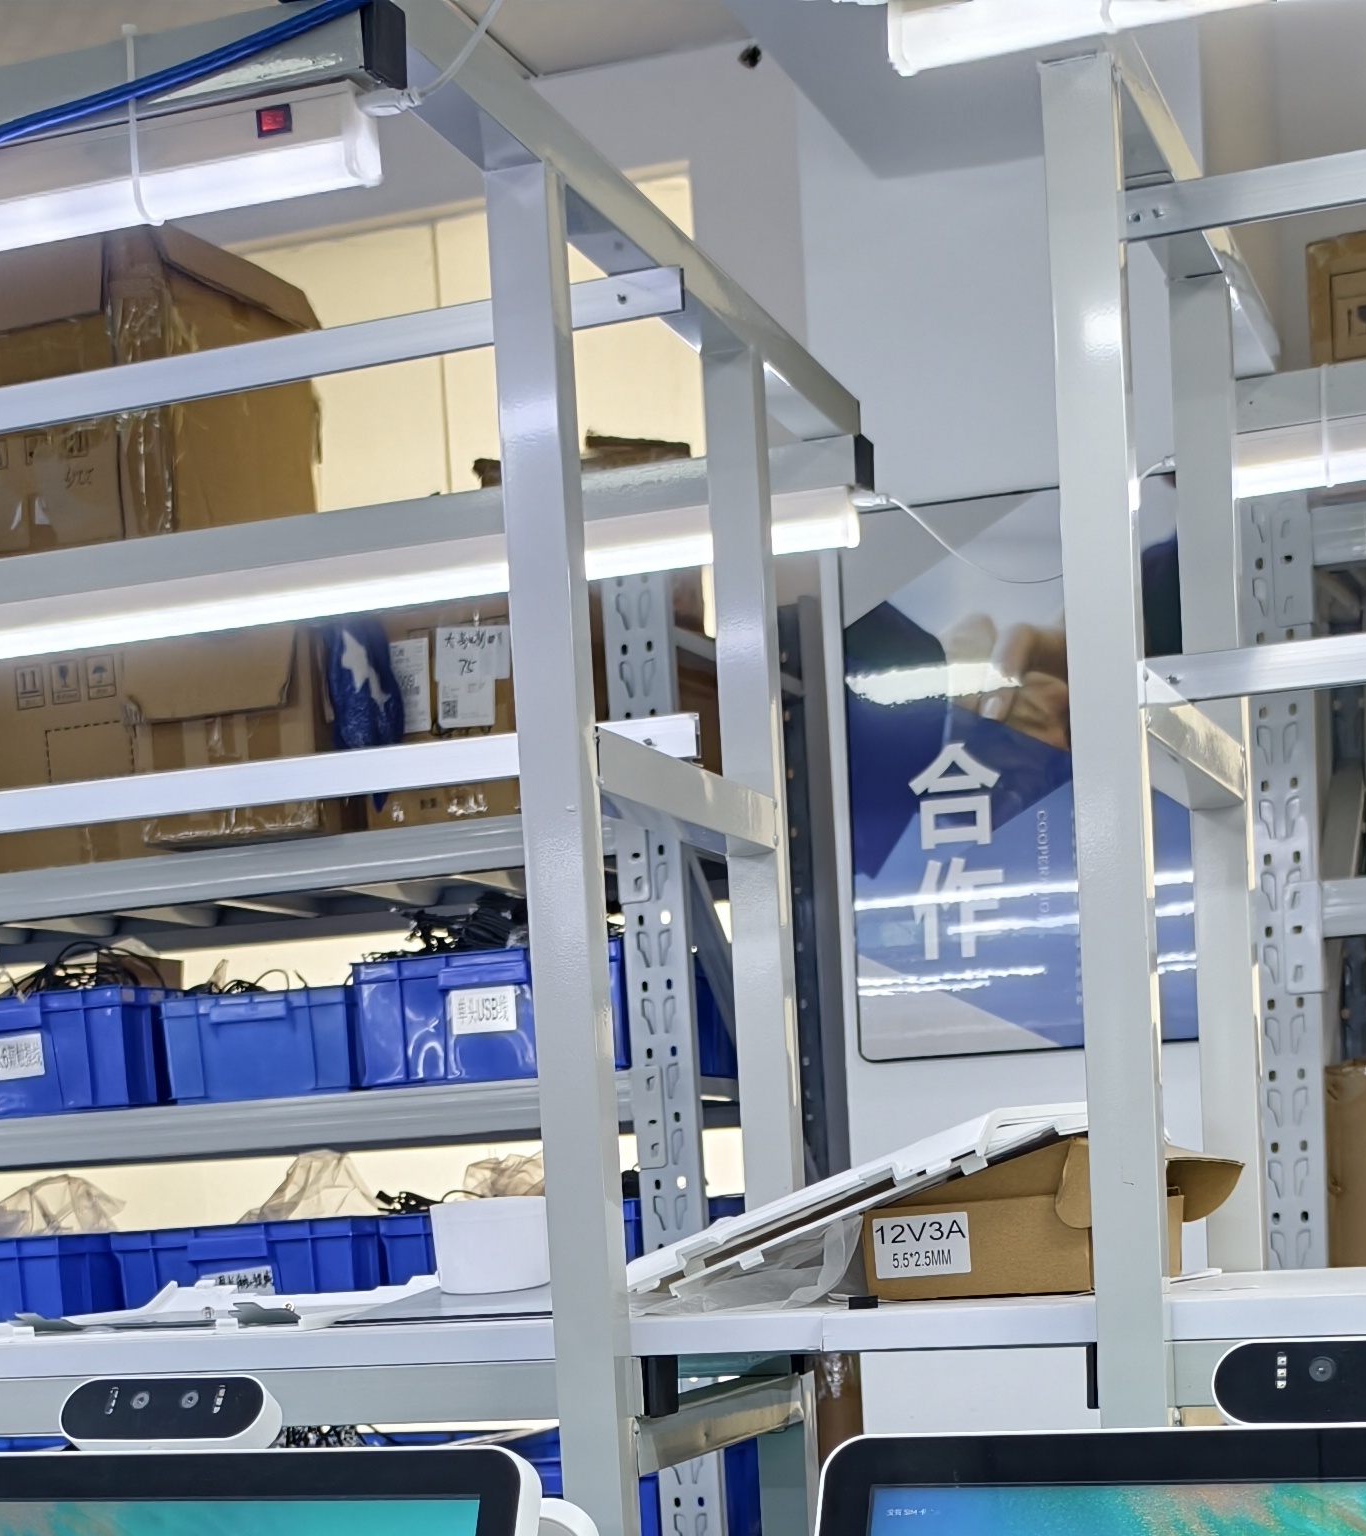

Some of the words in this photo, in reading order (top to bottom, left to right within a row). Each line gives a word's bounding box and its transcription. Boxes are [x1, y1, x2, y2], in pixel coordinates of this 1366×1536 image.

[457, 658, 478, 676] 75
[907, 741, 1004, 961] 合作
[874, 1220, 967, 1246] 12V3A
